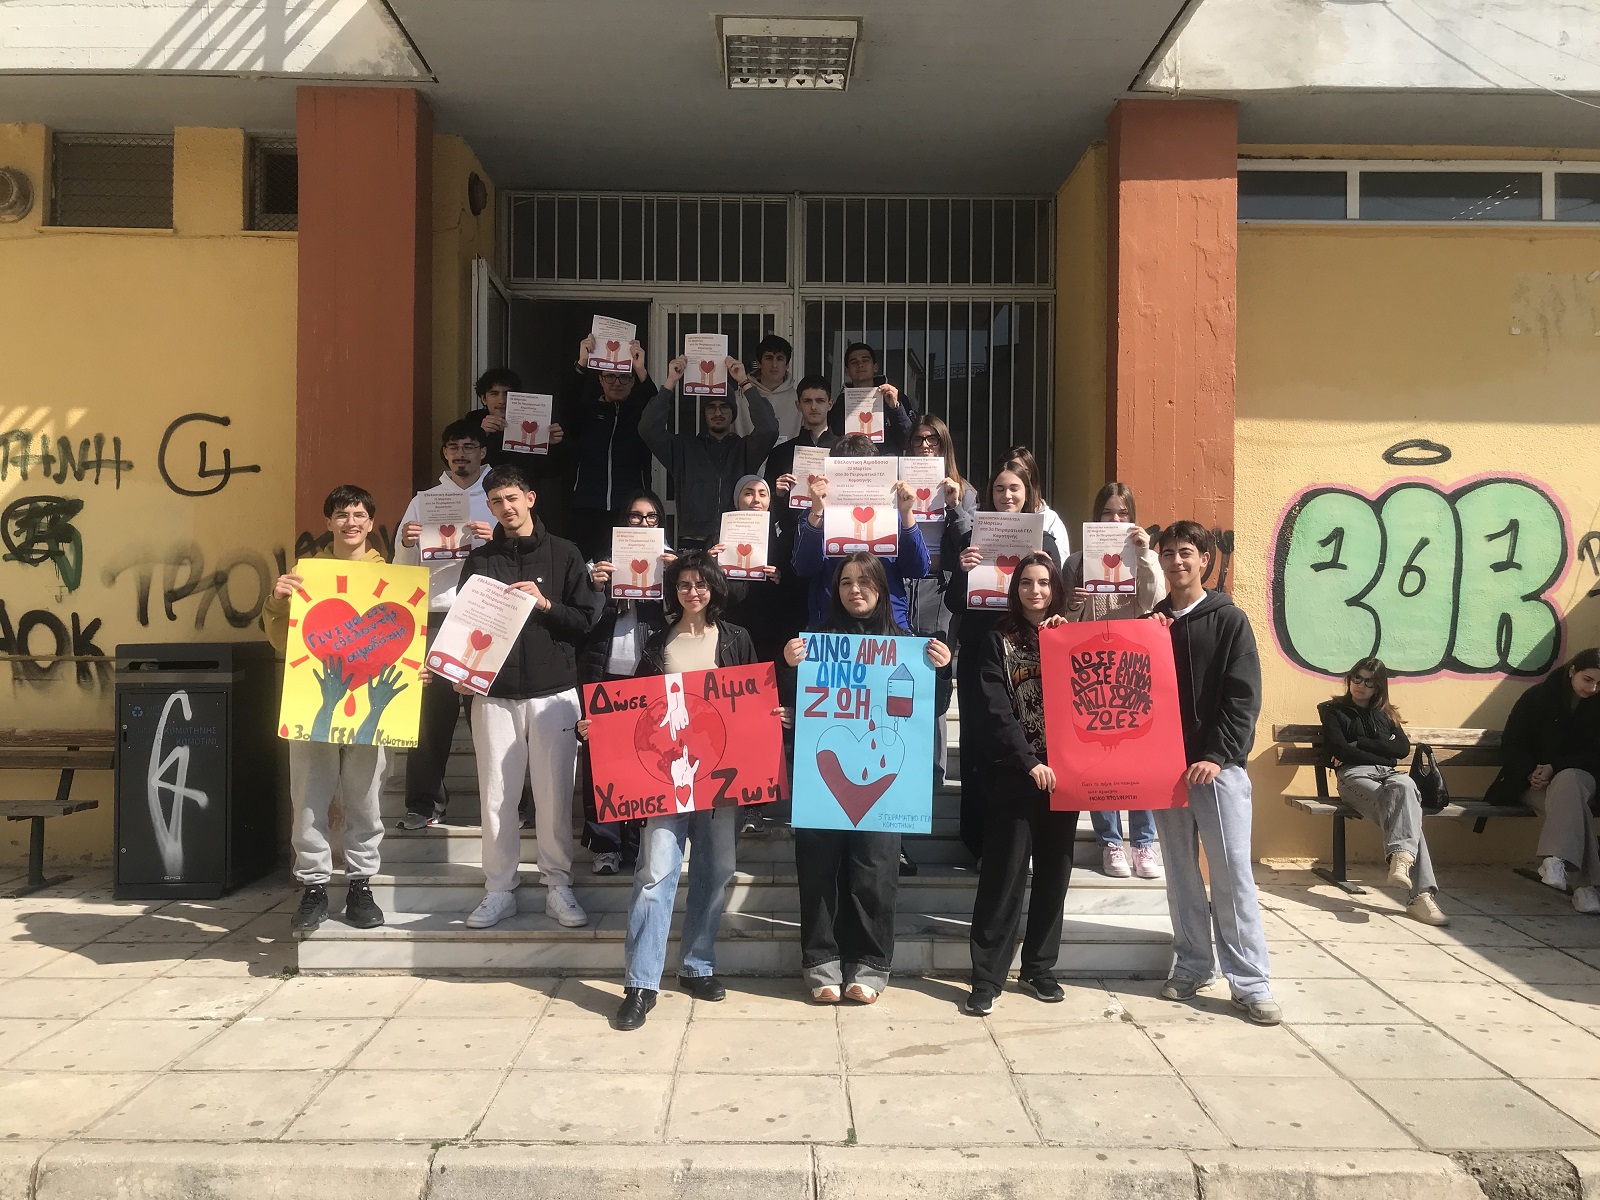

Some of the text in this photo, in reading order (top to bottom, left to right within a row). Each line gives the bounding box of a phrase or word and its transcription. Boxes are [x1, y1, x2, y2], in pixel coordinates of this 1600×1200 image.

[855, 638, 897, 666] ΑΙΜΑ
[1119, 651, 1151, 673] ΑΙΜΑ
[589, 672, 760, 715] Δώσε Αίμα
[804, 686, 871, 720] ΖΩΗ
[1072, 684, 1107, 715] ΜΑΖΙ
[1086, 710, 1140, 731] ΖΩΕΣ
[595, 767, 780, 821] Χάρισε Ζωή
